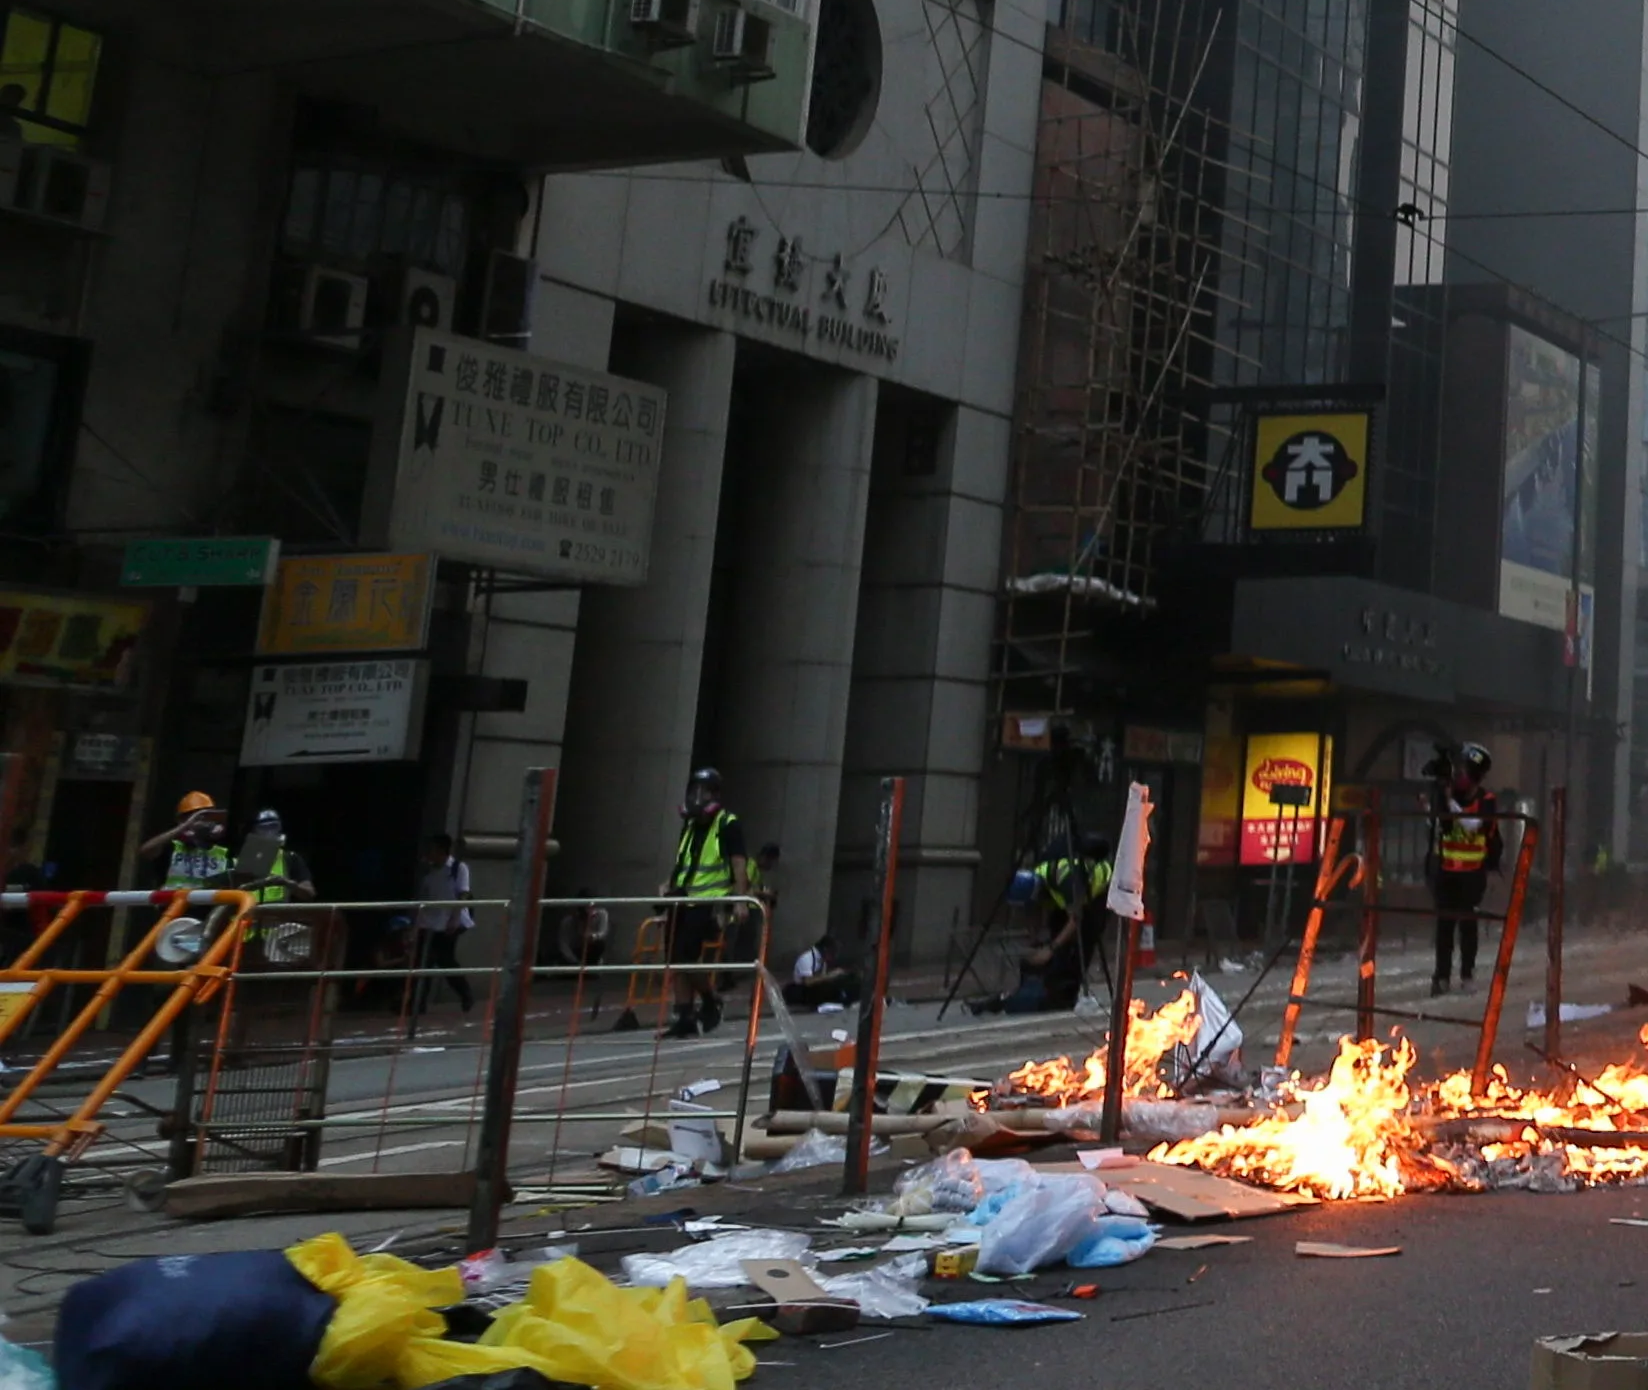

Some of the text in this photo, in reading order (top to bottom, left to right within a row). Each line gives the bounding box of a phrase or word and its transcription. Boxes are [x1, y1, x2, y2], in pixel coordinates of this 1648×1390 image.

[709, 279, 899, 362] EFFECTUAL BUILDING
[526, 416, 564, 448] TOP
